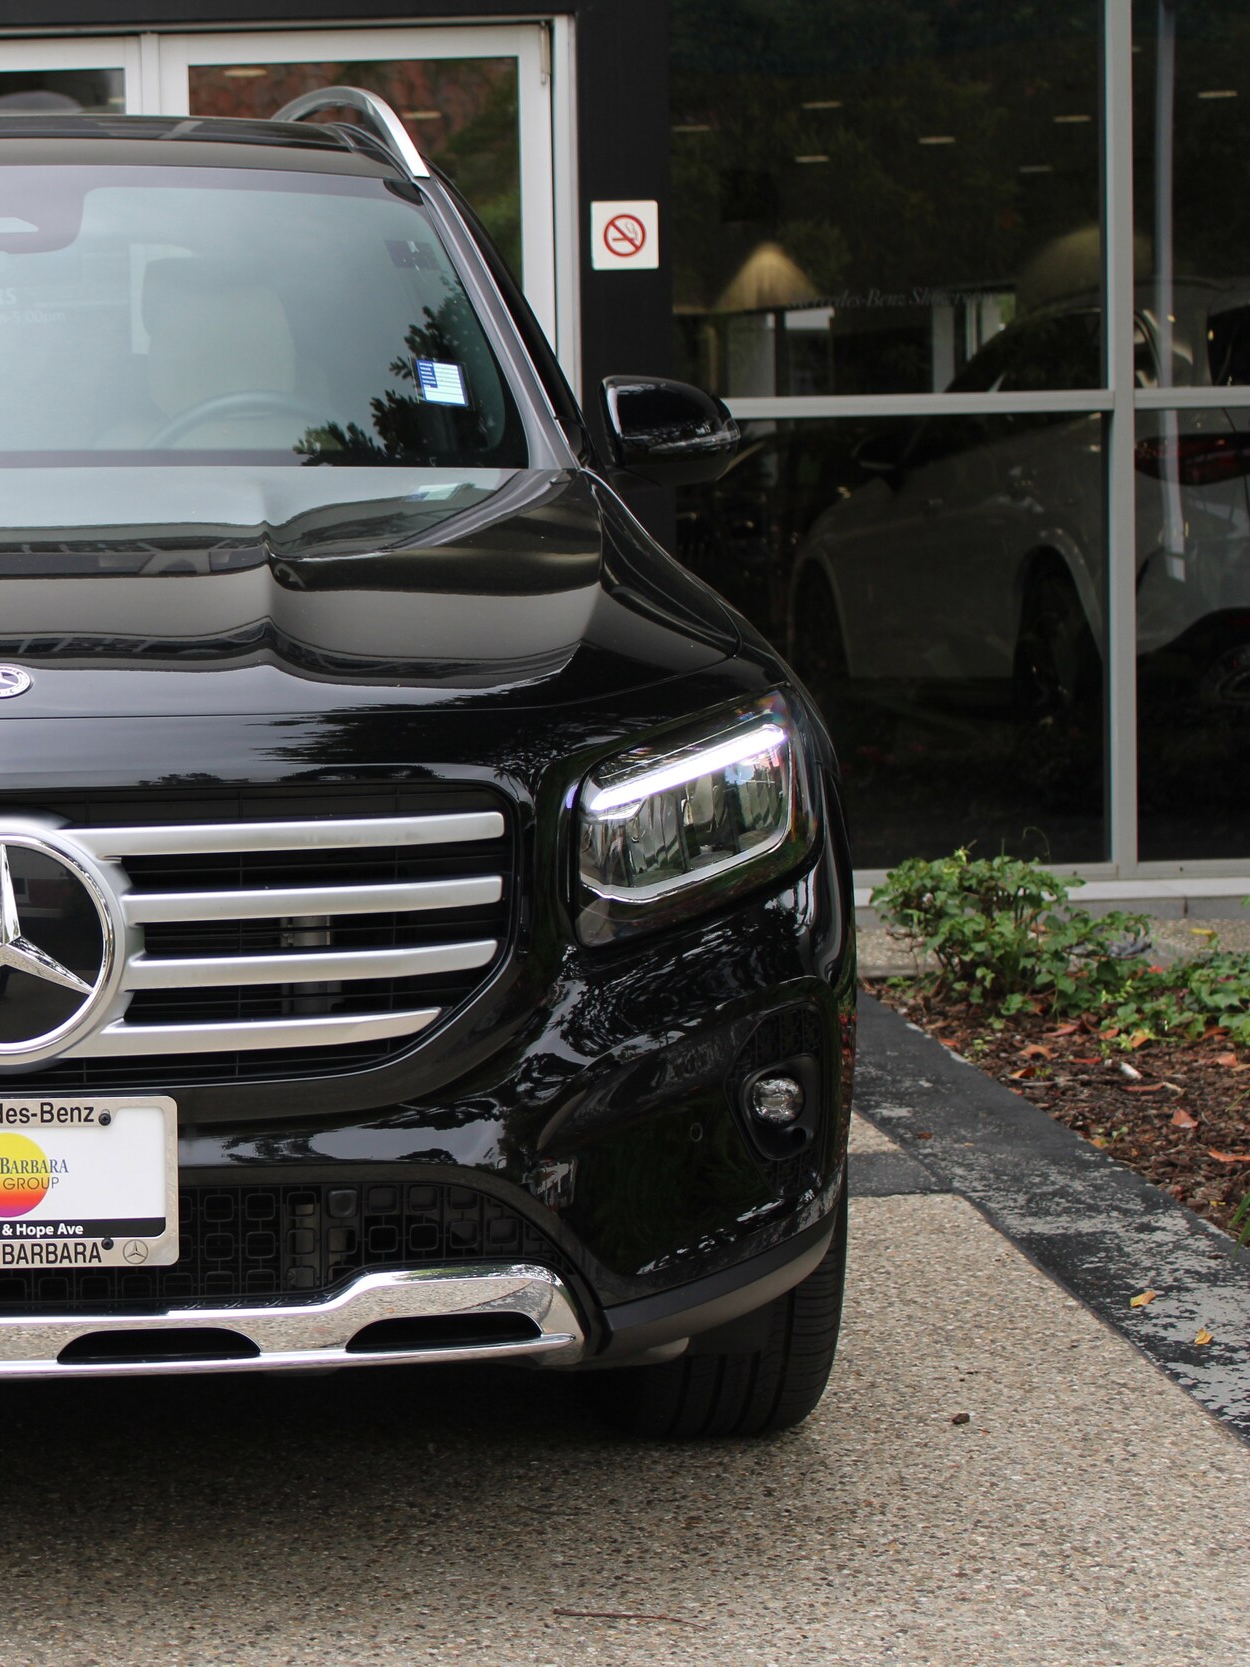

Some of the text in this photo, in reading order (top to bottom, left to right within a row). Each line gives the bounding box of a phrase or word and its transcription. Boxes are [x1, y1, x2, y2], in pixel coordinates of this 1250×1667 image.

[0, 1157, 69, 1175] BARBARA
[2, 1176, 60, 1191] GROUP
[2, 1224, 13, 1236] &
[16, 1223, 55, 1238] Hope
[57, 1223, 84, 1235] Ave
[2, 1242, 102, 1265] BARBARA
